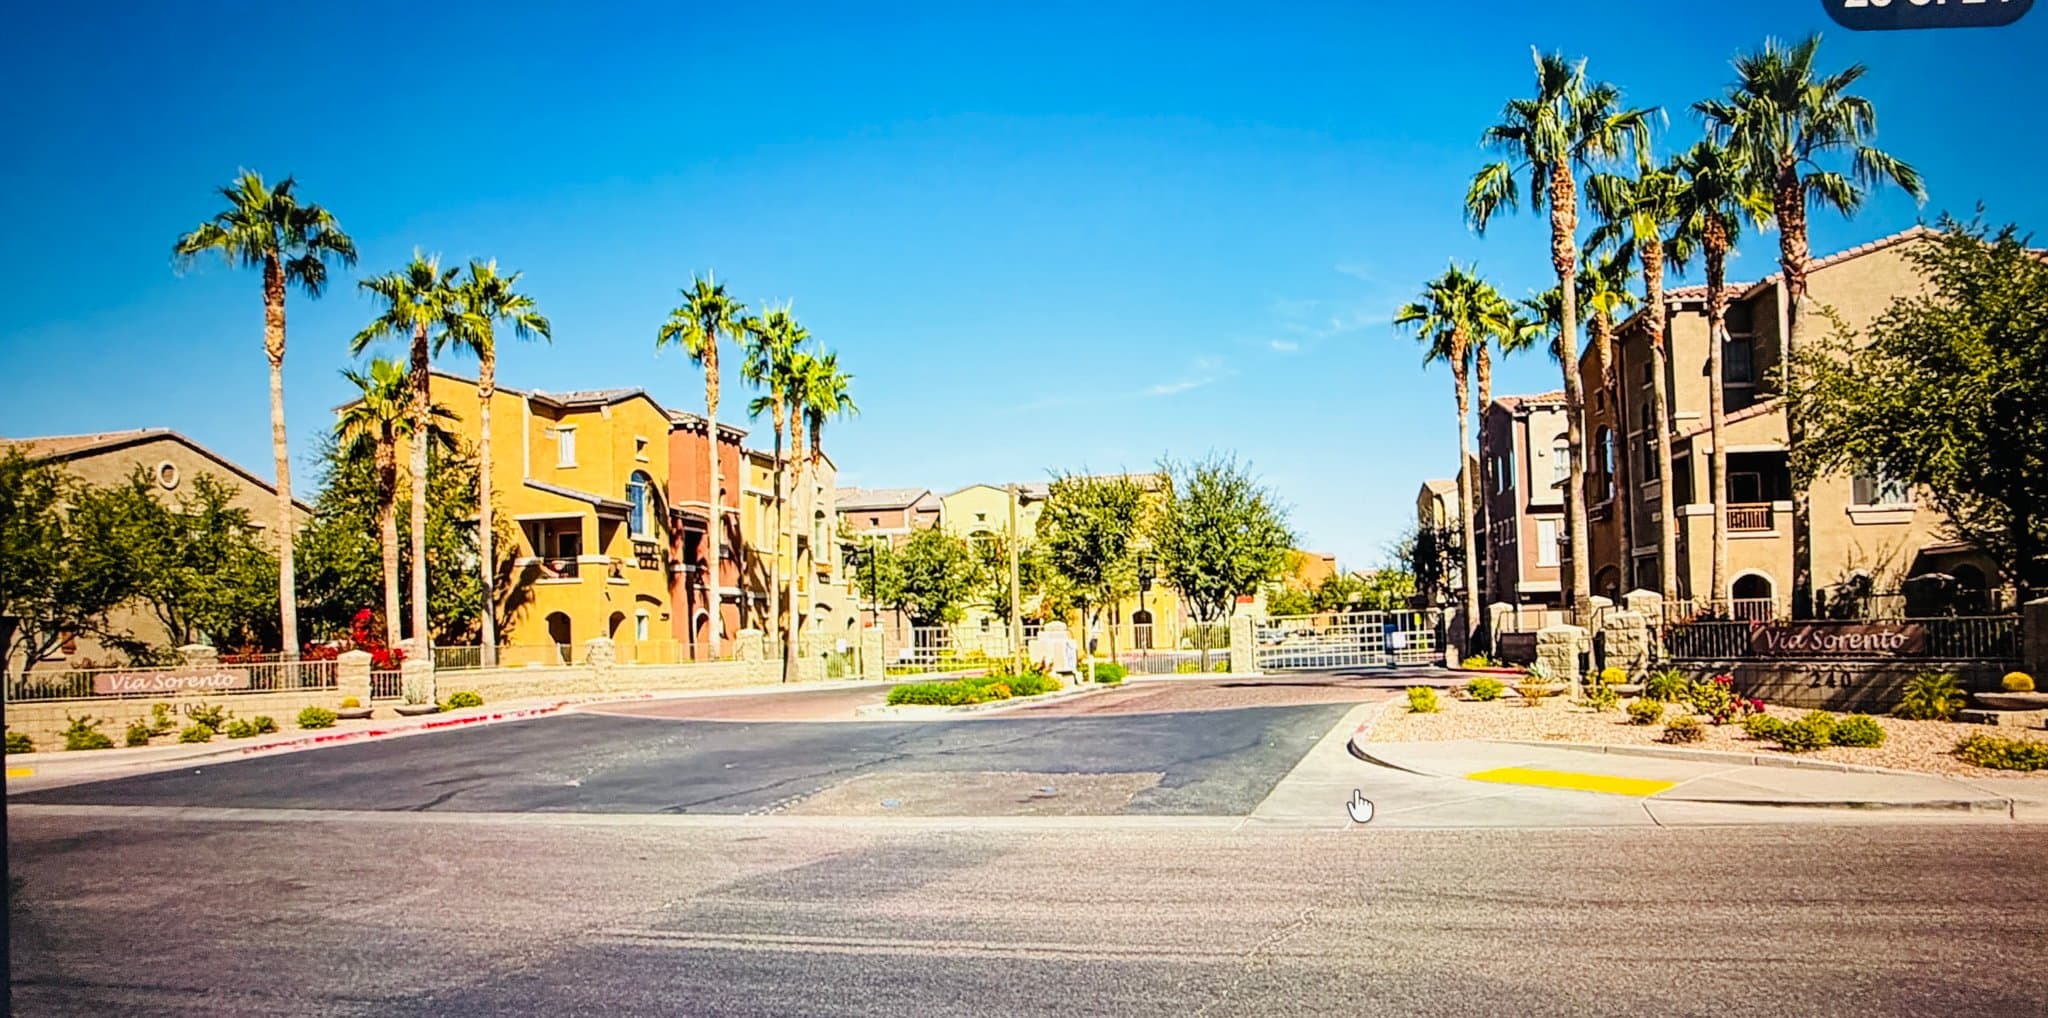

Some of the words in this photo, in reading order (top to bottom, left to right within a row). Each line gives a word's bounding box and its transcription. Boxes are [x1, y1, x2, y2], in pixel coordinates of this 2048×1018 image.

[1766, 630, 1808, 649] Via
[1810, 629, 1909, 650] Sorento
[110, 674, 152, 690] Via
[154, 672, 238, 688] Sorento
[1807, 669, 1852, 688] 240
